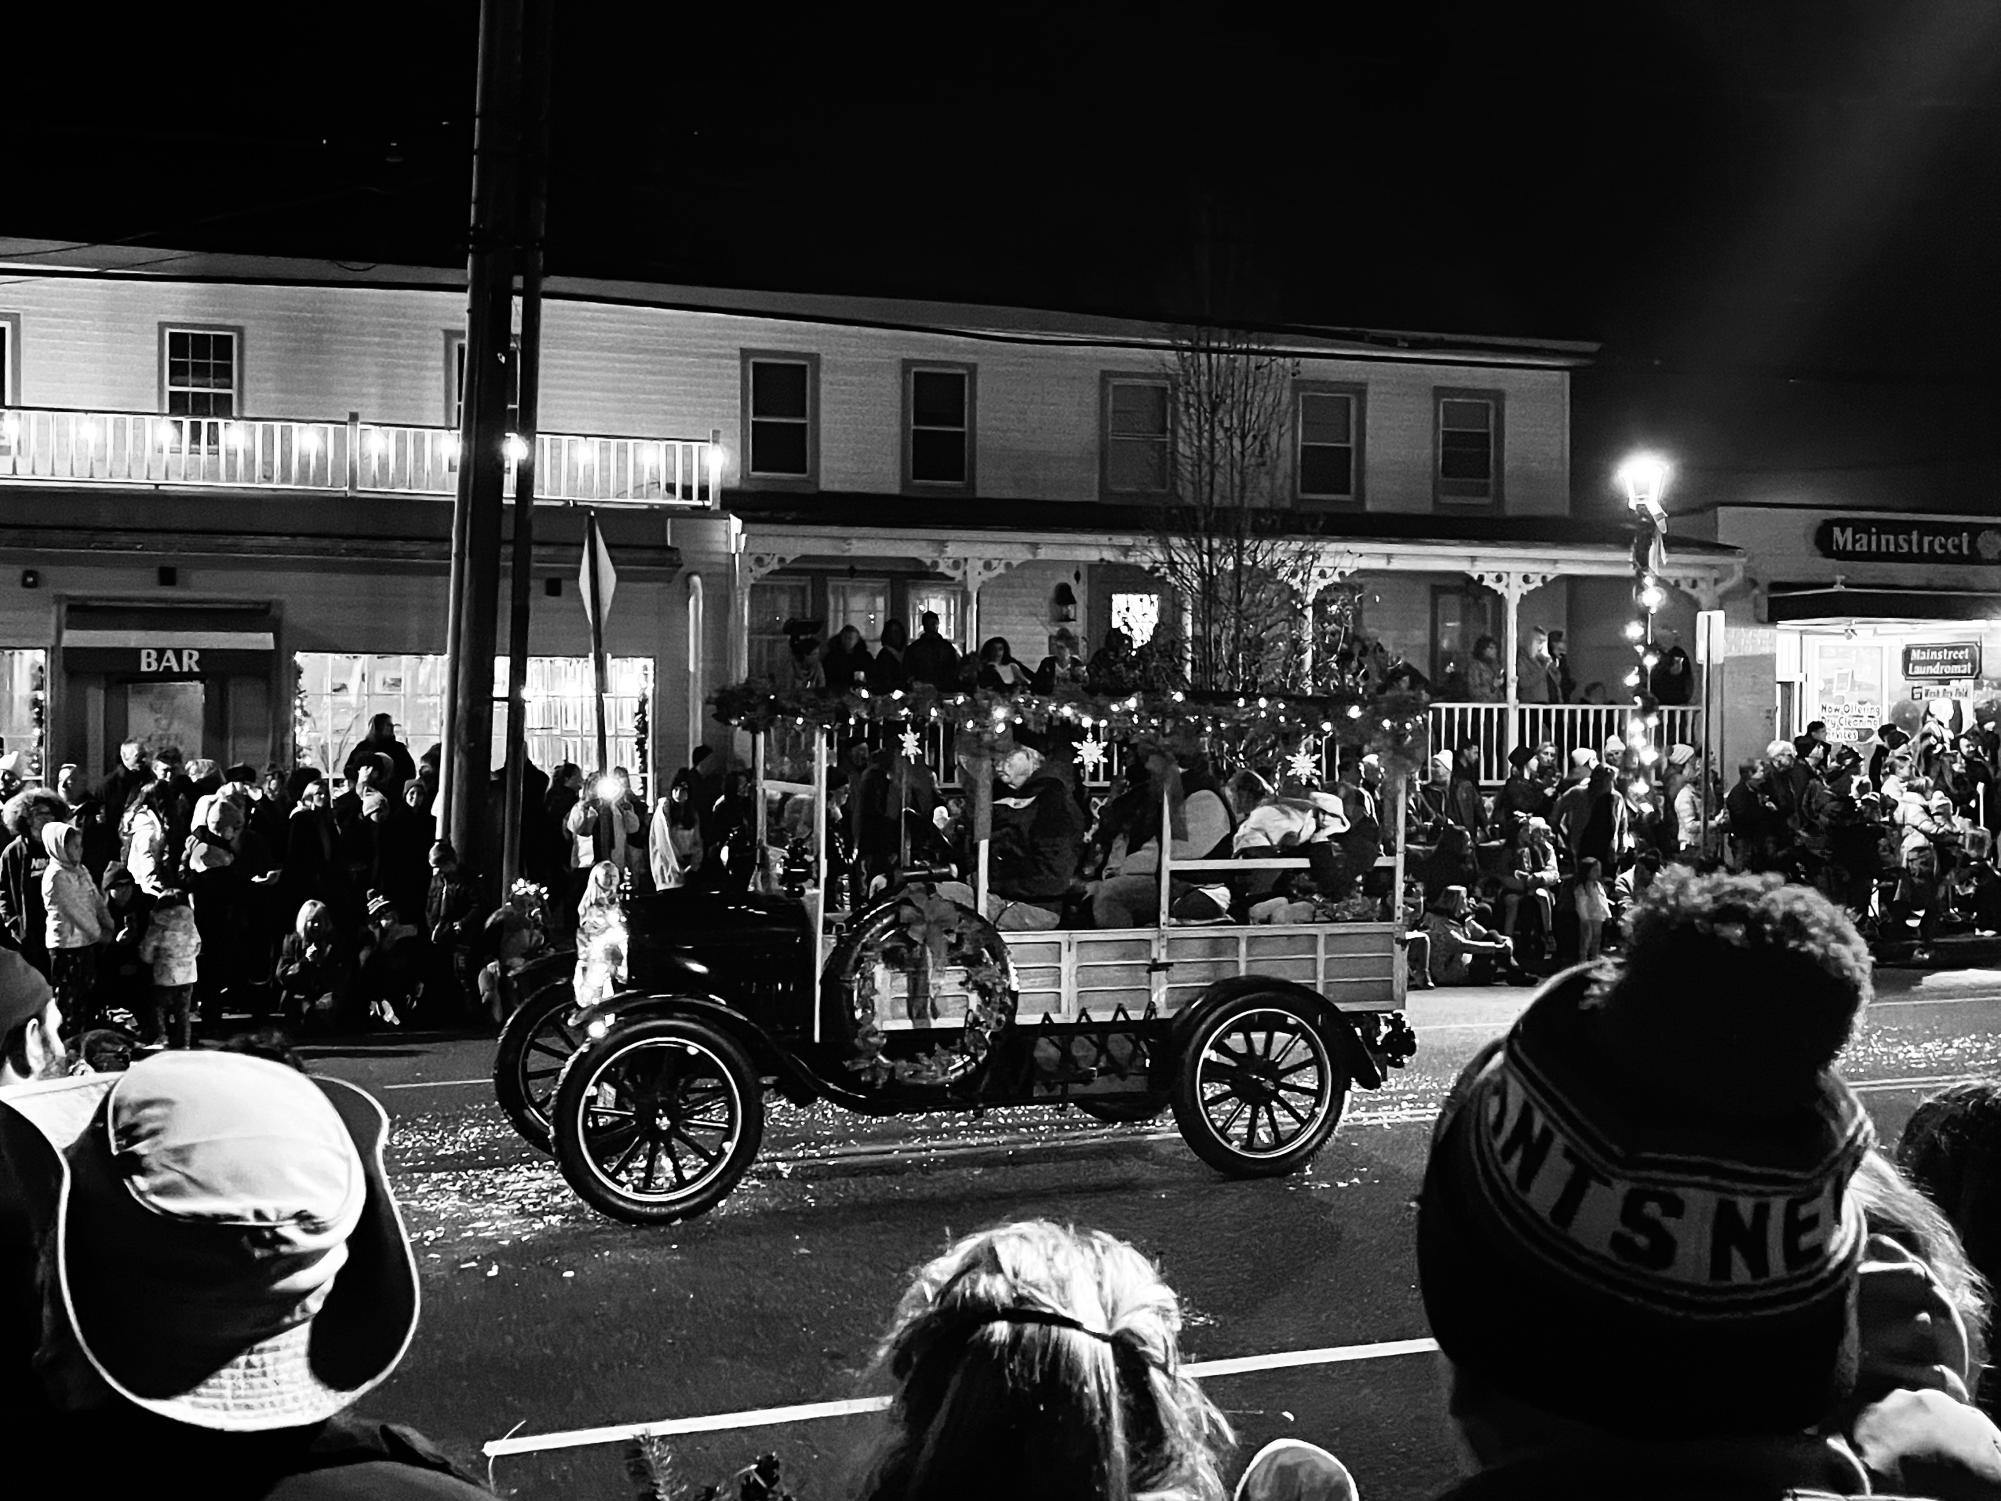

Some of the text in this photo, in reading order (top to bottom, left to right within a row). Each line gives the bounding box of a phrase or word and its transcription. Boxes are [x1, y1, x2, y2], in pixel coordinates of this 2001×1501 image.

[1832, 526, 1969, 554] Mainstreet
[140, 649, 200, 672] BAR
[1910, 648, 1969, 661] Mainstreet
[1908, 661, 1971, 675] Laundromat
[1821, 704, 1840, 713] Now
[1826, 729, 1857, 739] ervices
